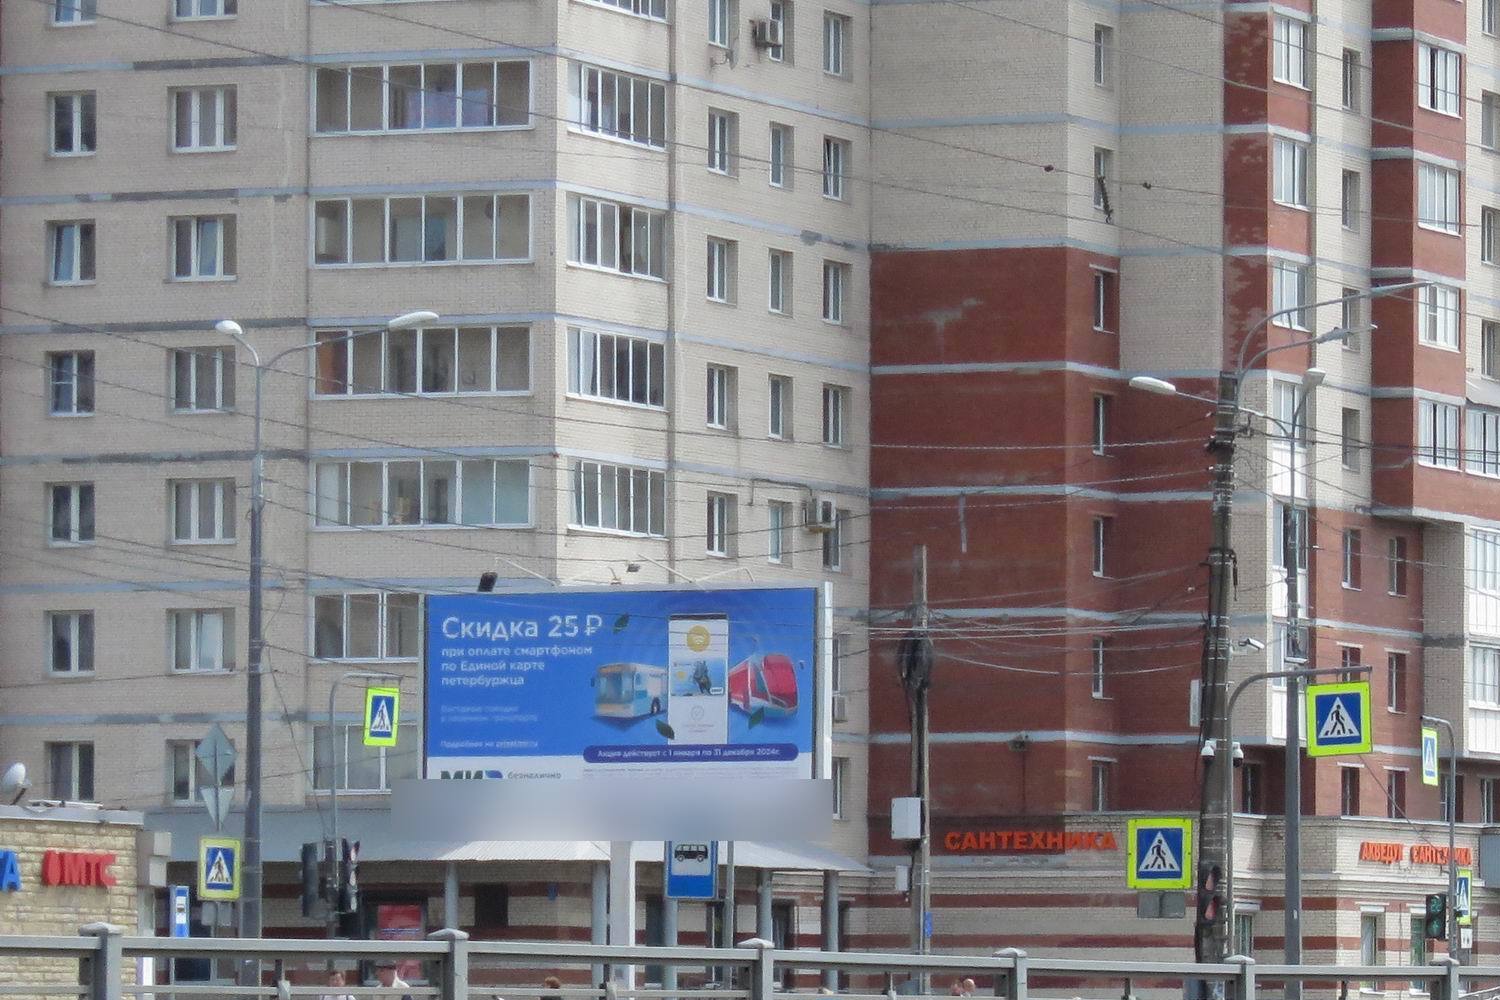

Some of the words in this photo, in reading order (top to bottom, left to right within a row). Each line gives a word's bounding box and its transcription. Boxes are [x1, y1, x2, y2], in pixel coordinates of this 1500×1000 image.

[442, 616, 538, 641] Скидка
[442, 647, 464, 657] при
[468, 647, 510, 656] оплате
[514, 645, 592, 658] смартфоном
[442, 662, 457, 671] по
[461, 659, 506, 672] Единой
[510, 661, 545, 671] карте
[442, 674, 524, 686] петербуржца
[944, 831, 1117, 849] САНТЕХНИКА
[1410, 846, 1471, 866] САНТЕХИКА
